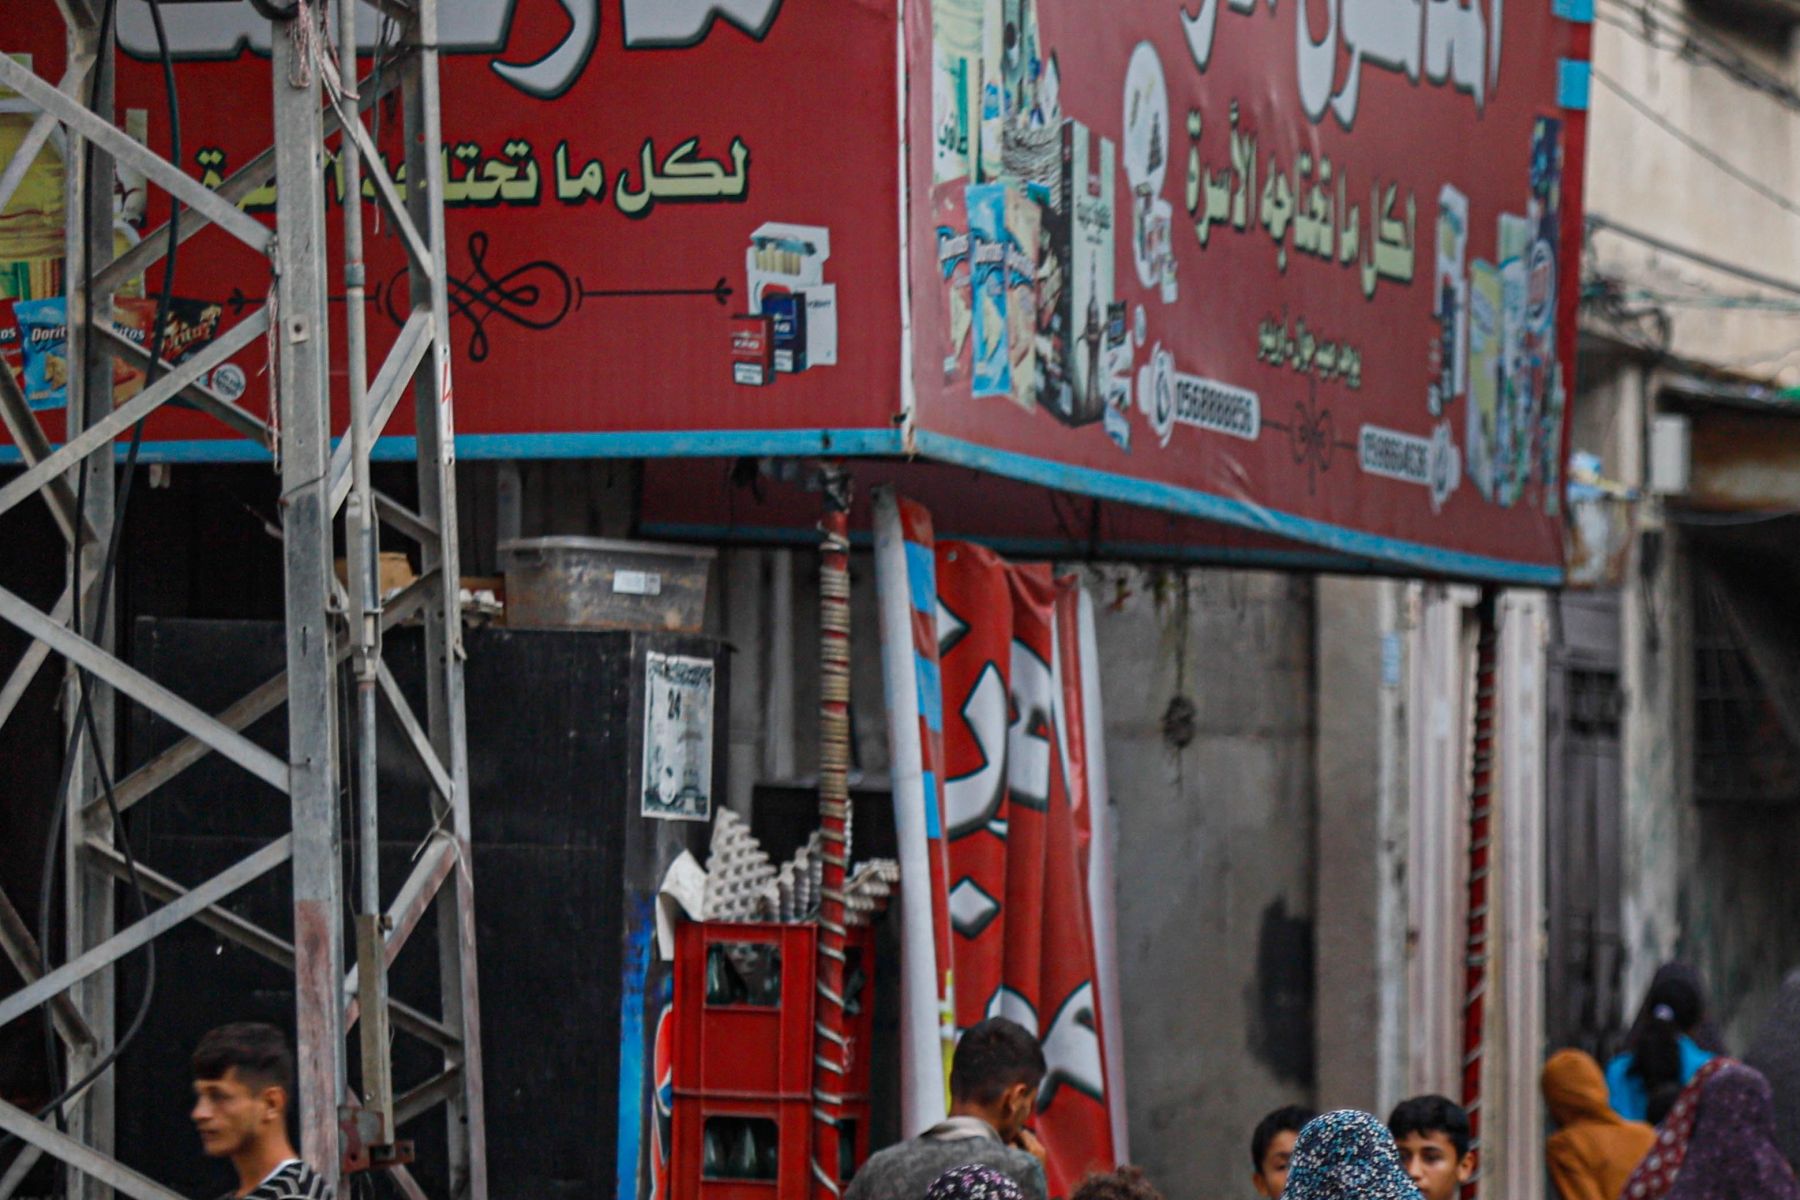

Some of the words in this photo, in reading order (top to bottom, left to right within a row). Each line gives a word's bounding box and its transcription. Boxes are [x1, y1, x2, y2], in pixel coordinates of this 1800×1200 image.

[554, 138, 604, 202] ما
[613, 136, 749, 216] لكل
[1185, 99, 1258, 248] الأسرة
[1337, 165, 1360, 266] ما
[1361, 177, 1416, 298] لكل
[31, 325, 68, 343] Dorit
